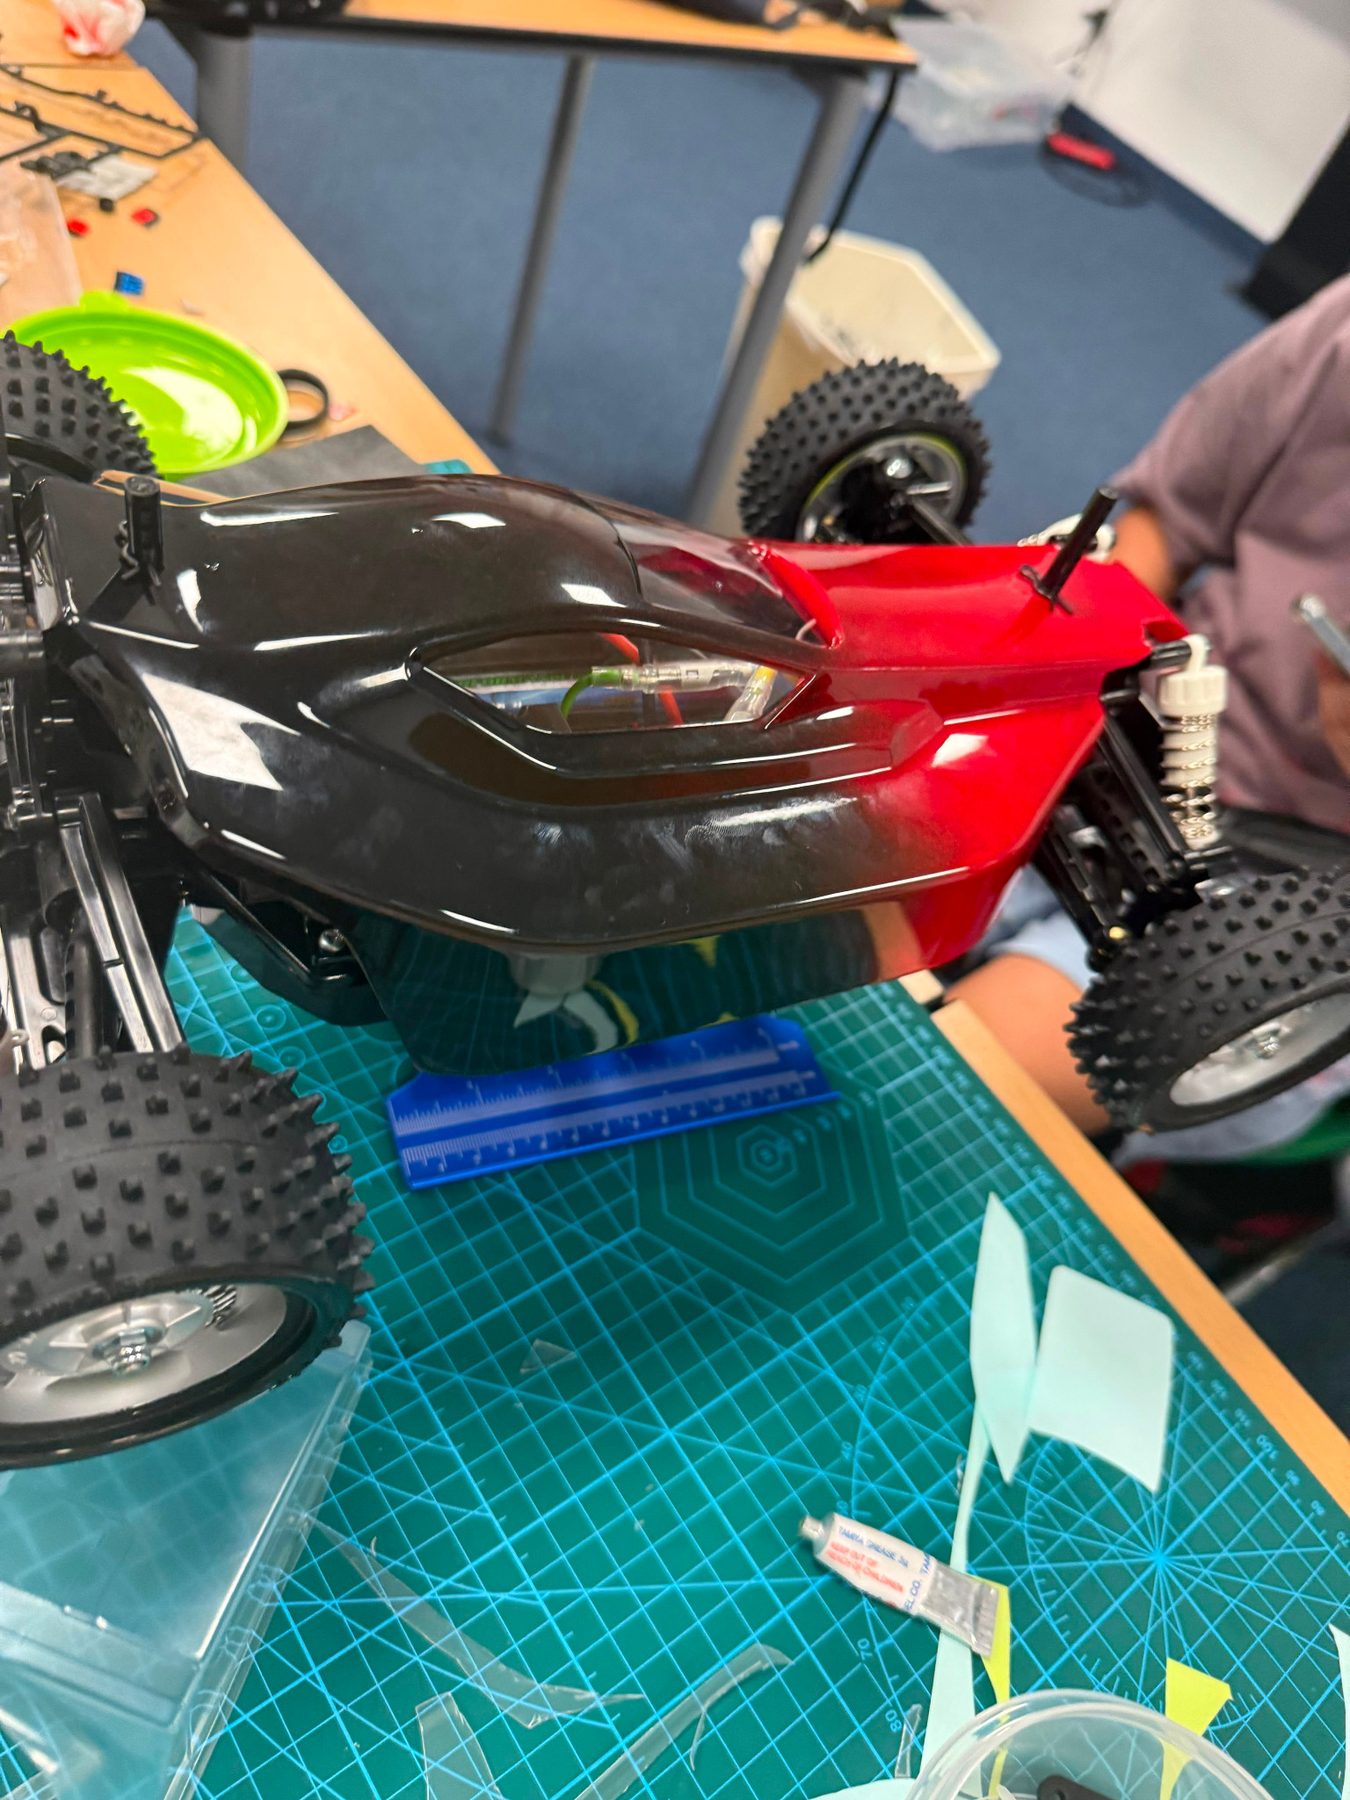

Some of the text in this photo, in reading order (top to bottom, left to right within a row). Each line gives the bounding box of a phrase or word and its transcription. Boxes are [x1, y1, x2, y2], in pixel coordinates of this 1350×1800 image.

[840, 1441, 853, 1462] 40
[1256, 1434, 1279, 1460] 100
[857, 1638, 873, 1661] 70
[884, 1709, 902, 1733] 80
